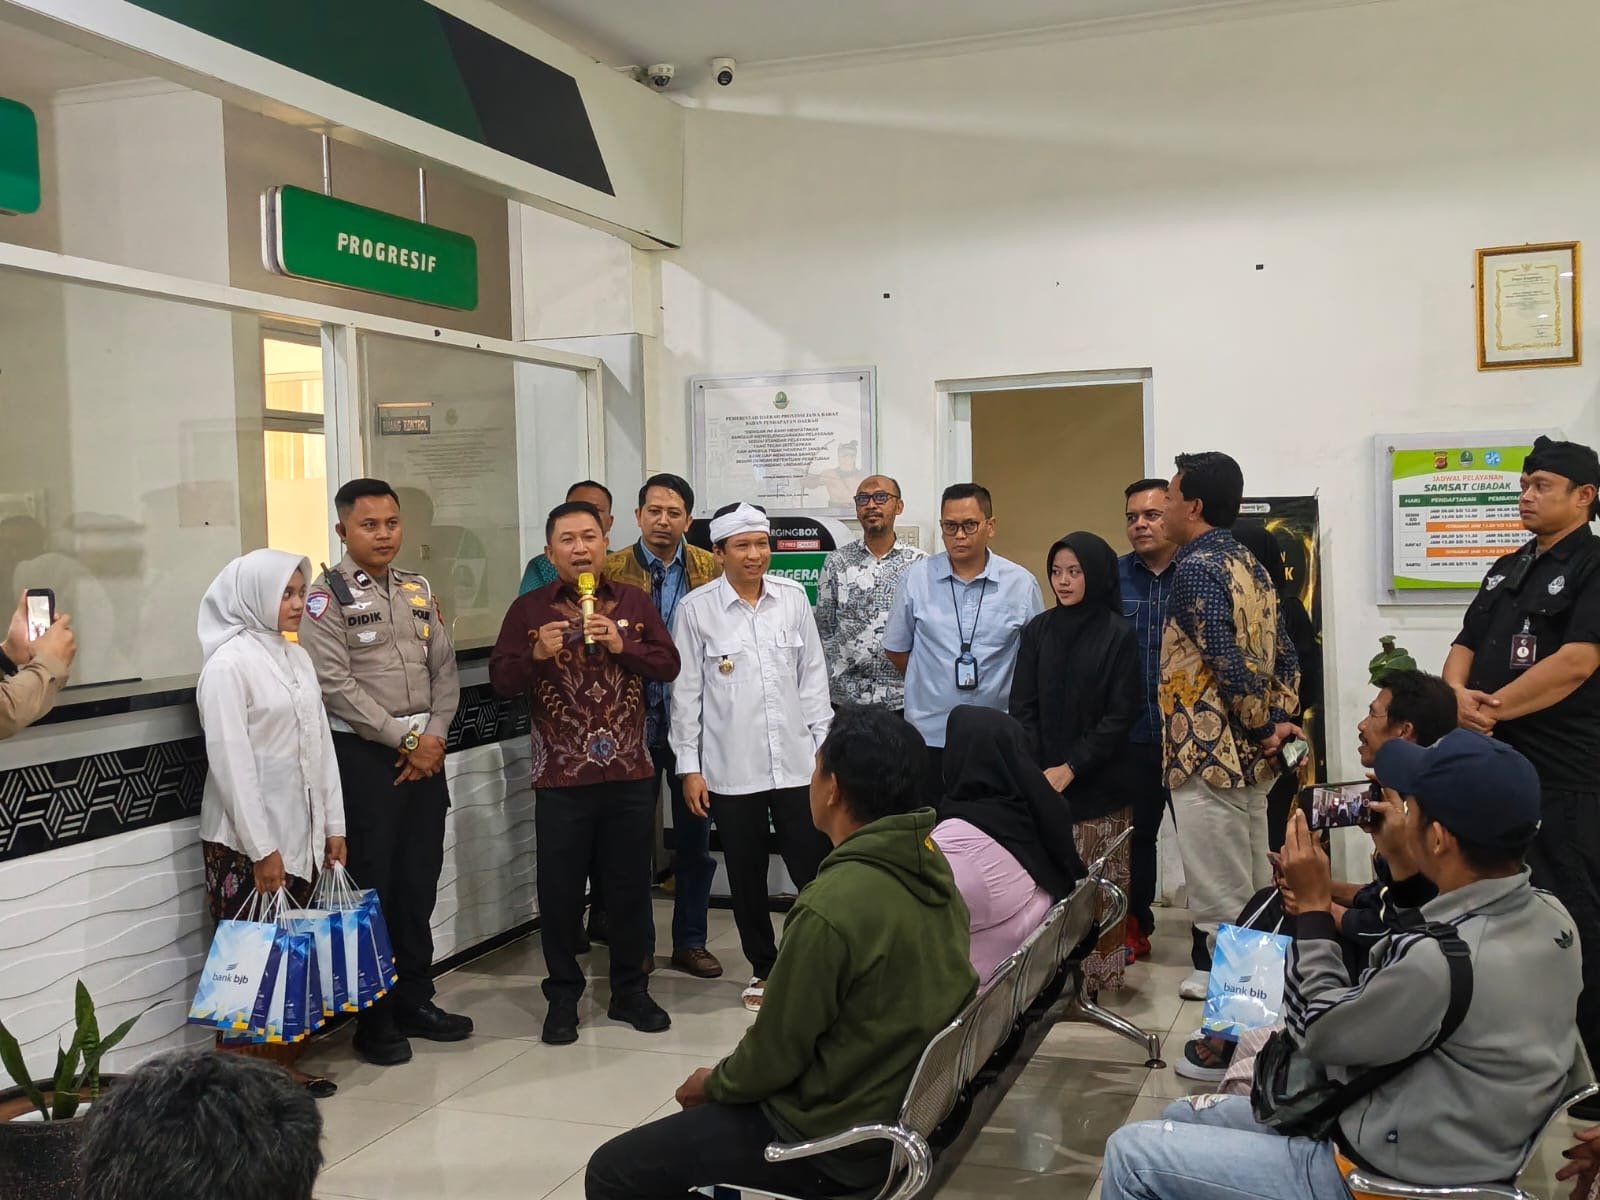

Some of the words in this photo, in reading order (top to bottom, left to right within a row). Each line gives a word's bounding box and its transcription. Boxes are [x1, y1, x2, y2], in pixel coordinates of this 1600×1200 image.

[337, 232, 437, 273] PROGRESIF
[1424, 483, 1469, 492] SAMSAT
[1471, 482, 1511, 491] CIBADAK
[769, 527, 818, 537] RGINGBOX
[767, 568, 819, 581] ERGERA
[347, 611, 382, 627] DIDIK
[212, 973, 232, 983] bank
[233, 974, 249, 985] bjb
[1223, 982, 1248, 996] bank
